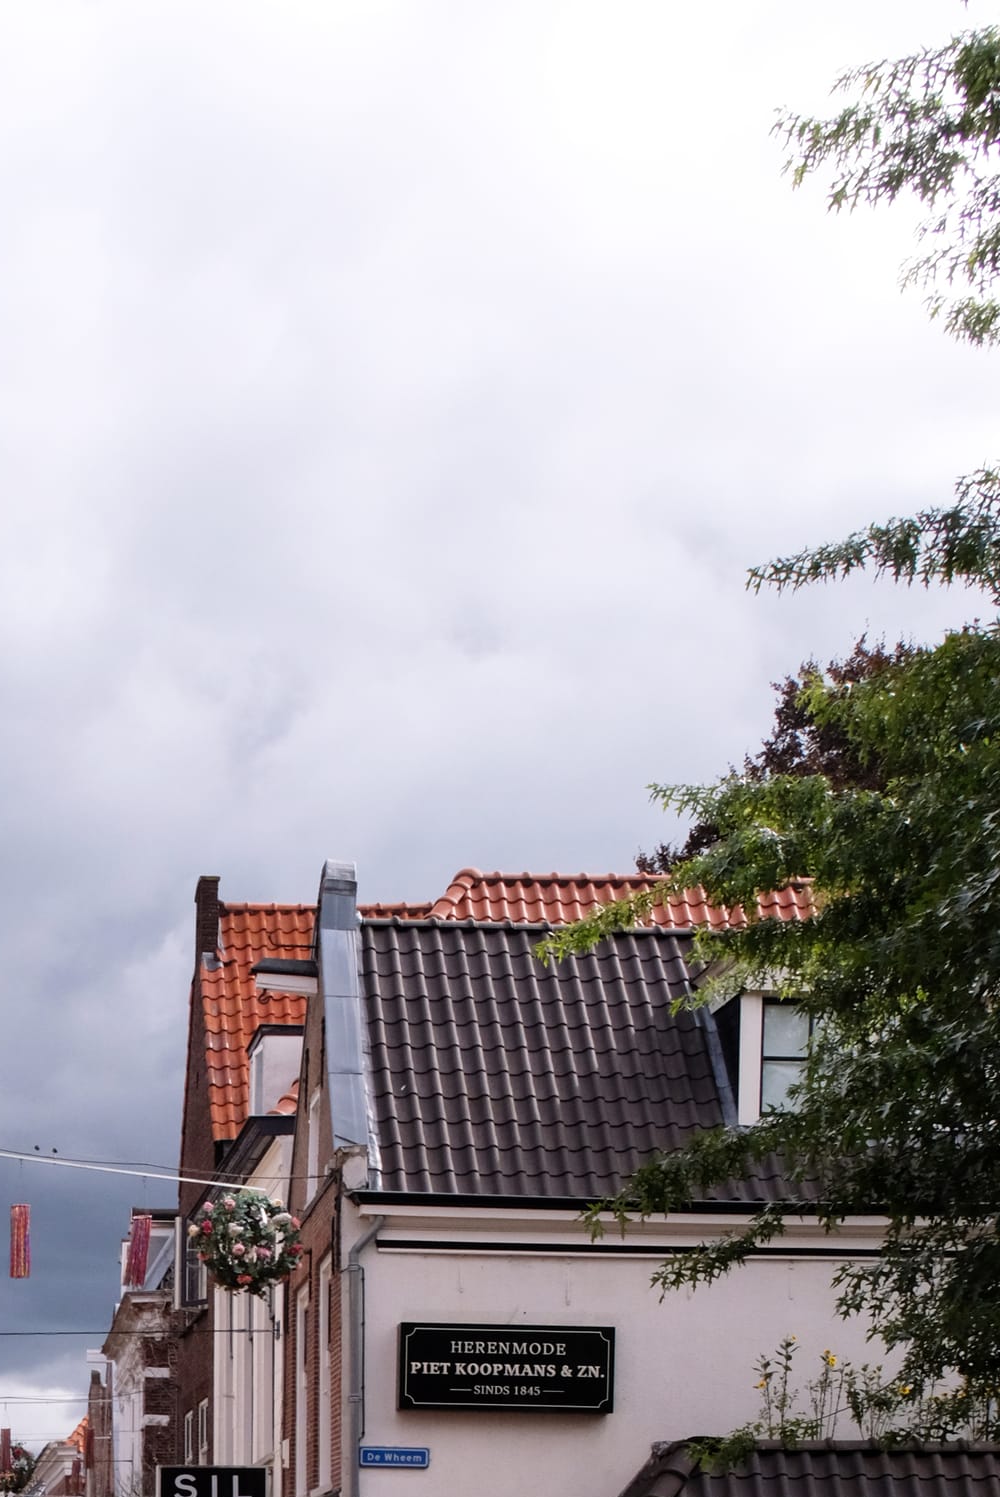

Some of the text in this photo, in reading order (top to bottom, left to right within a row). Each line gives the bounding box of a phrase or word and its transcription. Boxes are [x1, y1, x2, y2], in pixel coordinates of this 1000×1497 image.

[450, 1340, 567, 1356] HERENMODE
[410, 1361, 605, 1379] PIET KOOPMANS & ZN.
[473, 1384, 541, 1396] SINDS 1845
[367, 1452, 423, 1463] De Wheem
